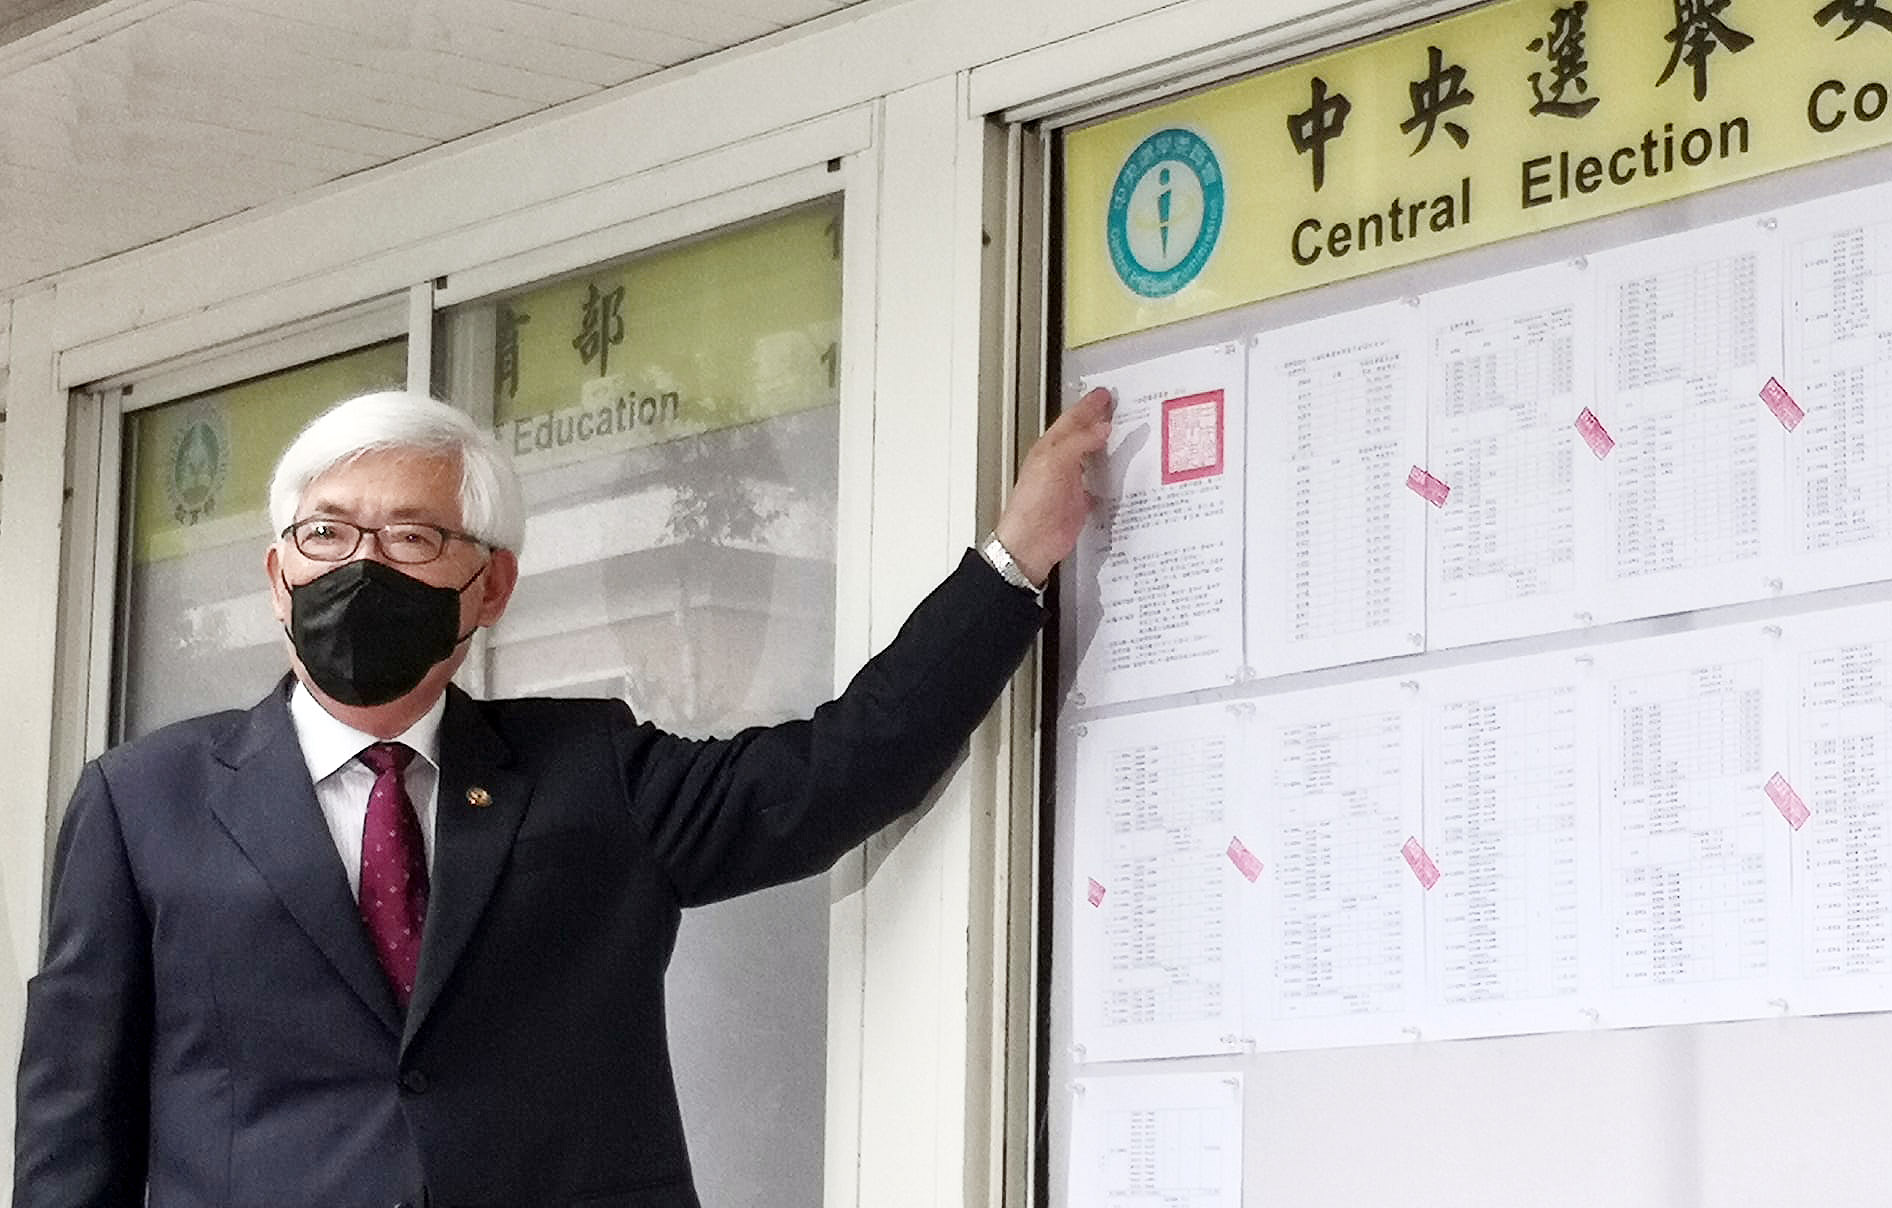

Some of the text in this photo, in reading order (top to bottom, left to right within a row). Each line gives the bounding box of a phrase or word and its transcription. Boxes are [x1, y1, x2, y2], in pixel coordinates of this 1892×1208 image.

[1291, 177, 1471, 266] Central
[1521, 117, 1749, 209] Election
[1807, 79, 1889, 133] Co
[513, 391, 681, 457] Education
